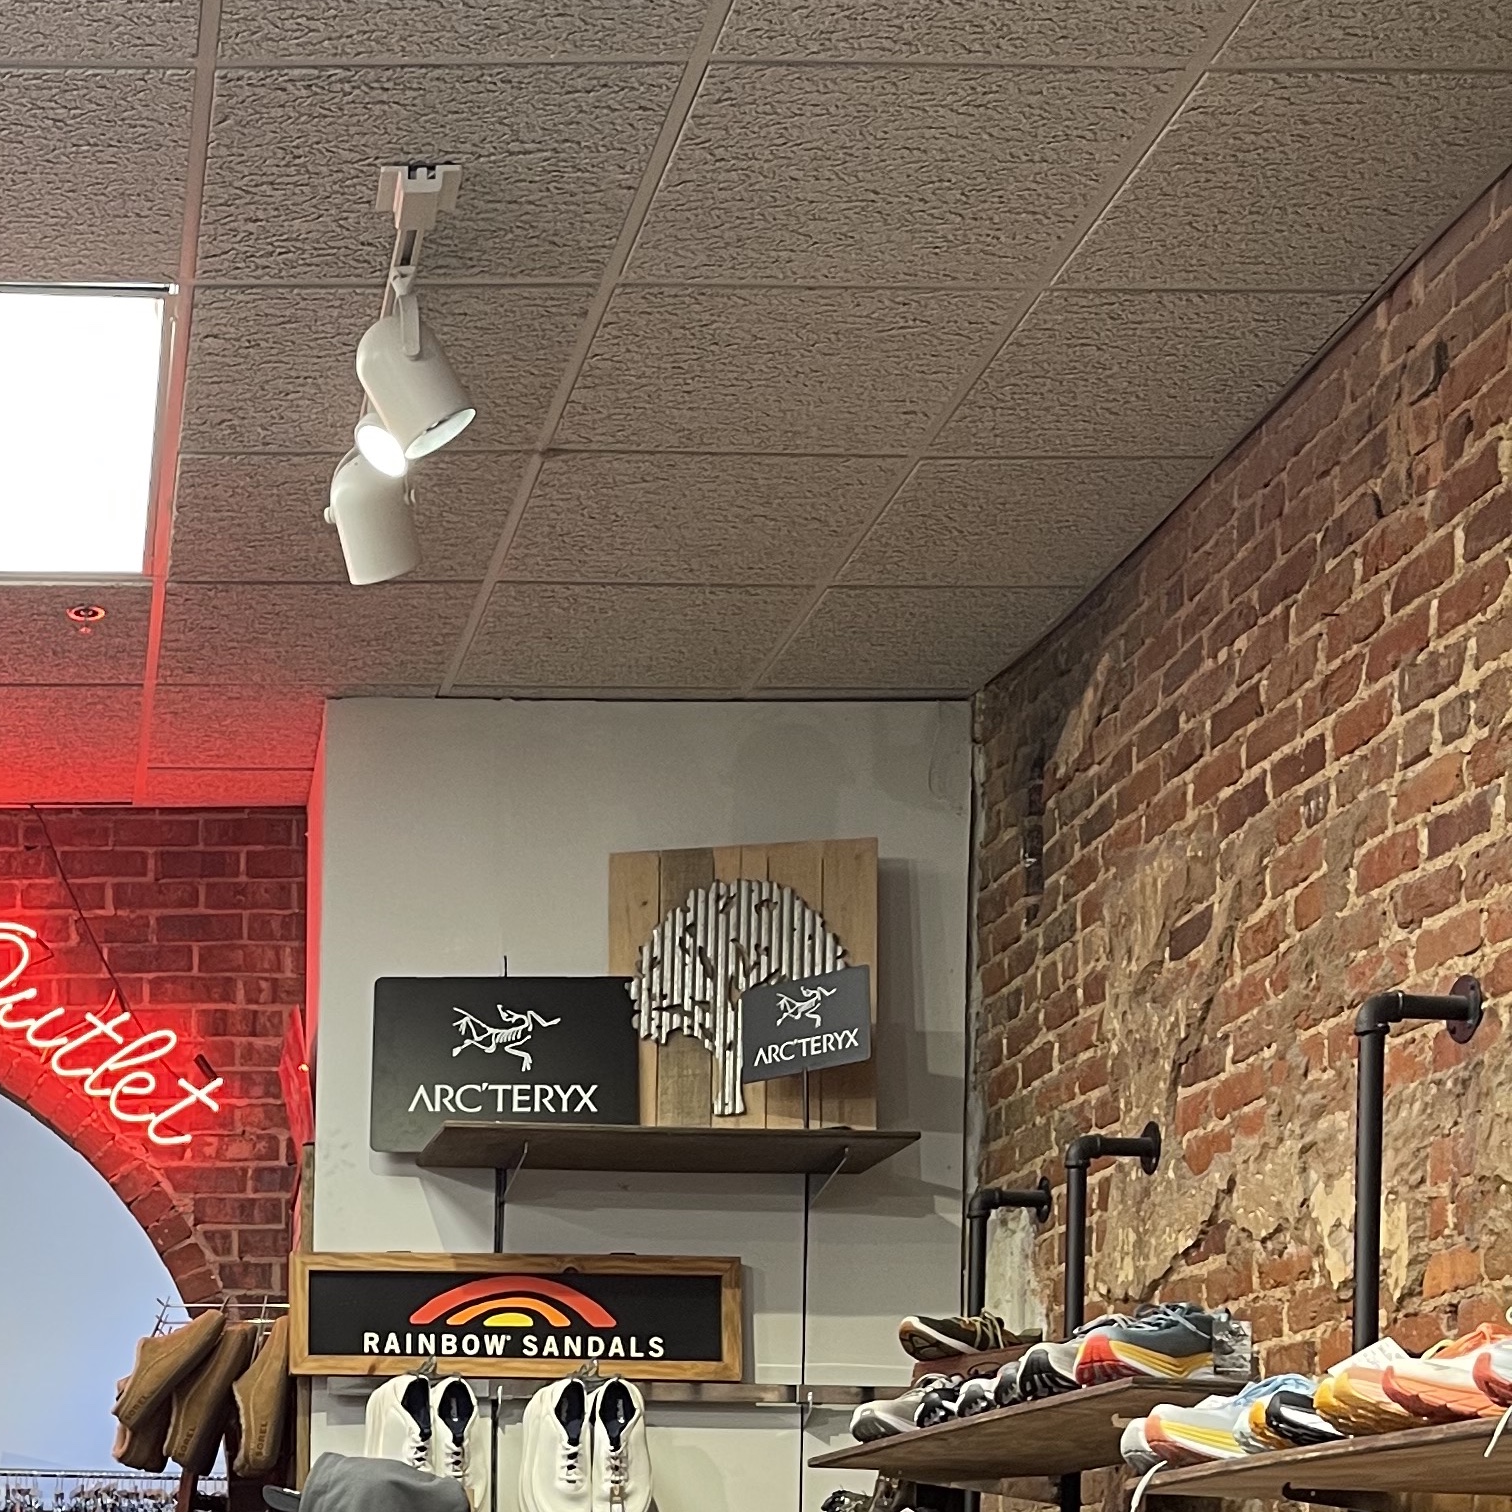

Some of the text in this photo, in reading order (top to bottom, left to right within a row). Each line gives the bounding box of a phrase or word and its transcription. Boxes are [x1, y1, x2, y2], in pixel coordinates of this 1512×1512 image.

[753, 1027, 859, 1067] ARC'TERYX
[407, 1083, 598, 1113] ARC'TERYX
[523, 1335, 664, 1358] SANDALS
[124, 1395, 148, 1421] SOREL
[178, 1426, 196, 1458] SOREL
[256, 1421, 269, 1457] SOREL
